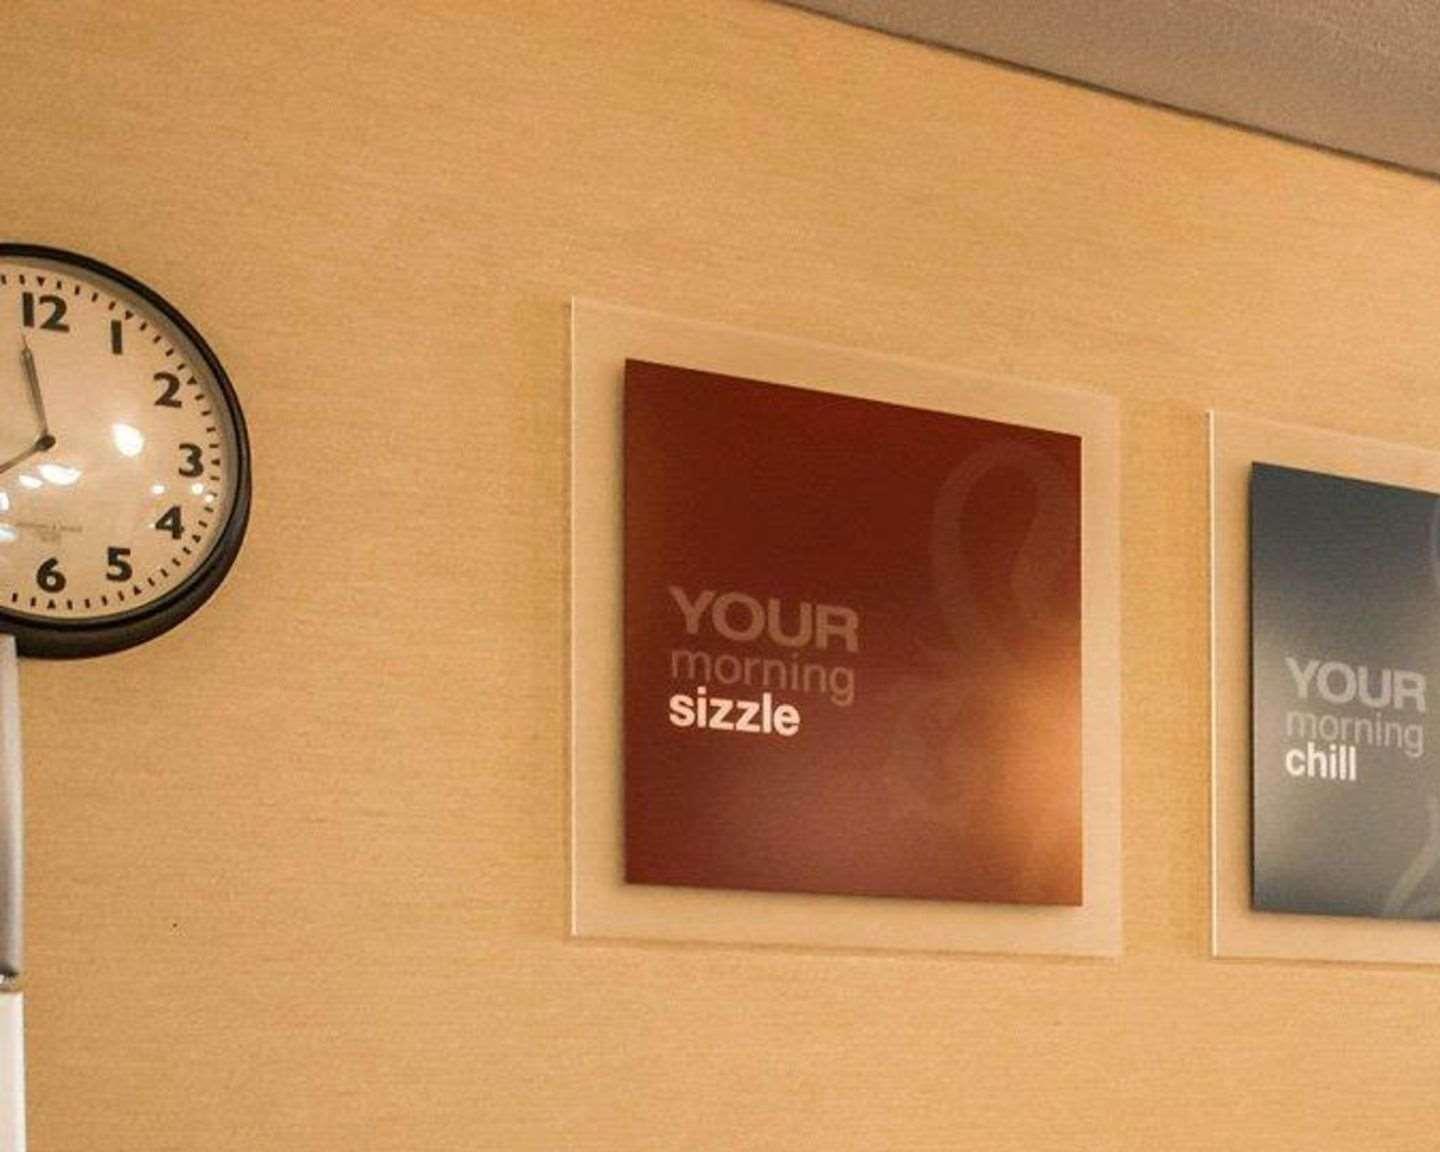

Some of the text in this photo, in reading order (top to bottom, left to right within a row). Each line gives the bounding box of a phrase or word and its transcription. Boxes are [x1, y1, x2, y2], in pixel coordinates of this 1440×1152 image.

[22, 292, 70, 333] 12
[111, 320, 123, 354] 1
[153, 372, 182, 408] 2
[178, 443, 204, 478] 3
[155, 506, 183, 540] 4
[36, 557, 66, 593] 6
[106, 547, 133, 582] 5
[668, 586, 859, 651] YOUR
[671, 649, 855, 706] morning
[1286, 657, 1427, 712] YOUR
[668, 686, 800, 736] sizzle
[1286, 711, 1424, 758] morning
[1285, 742, 1357, 781] chill
